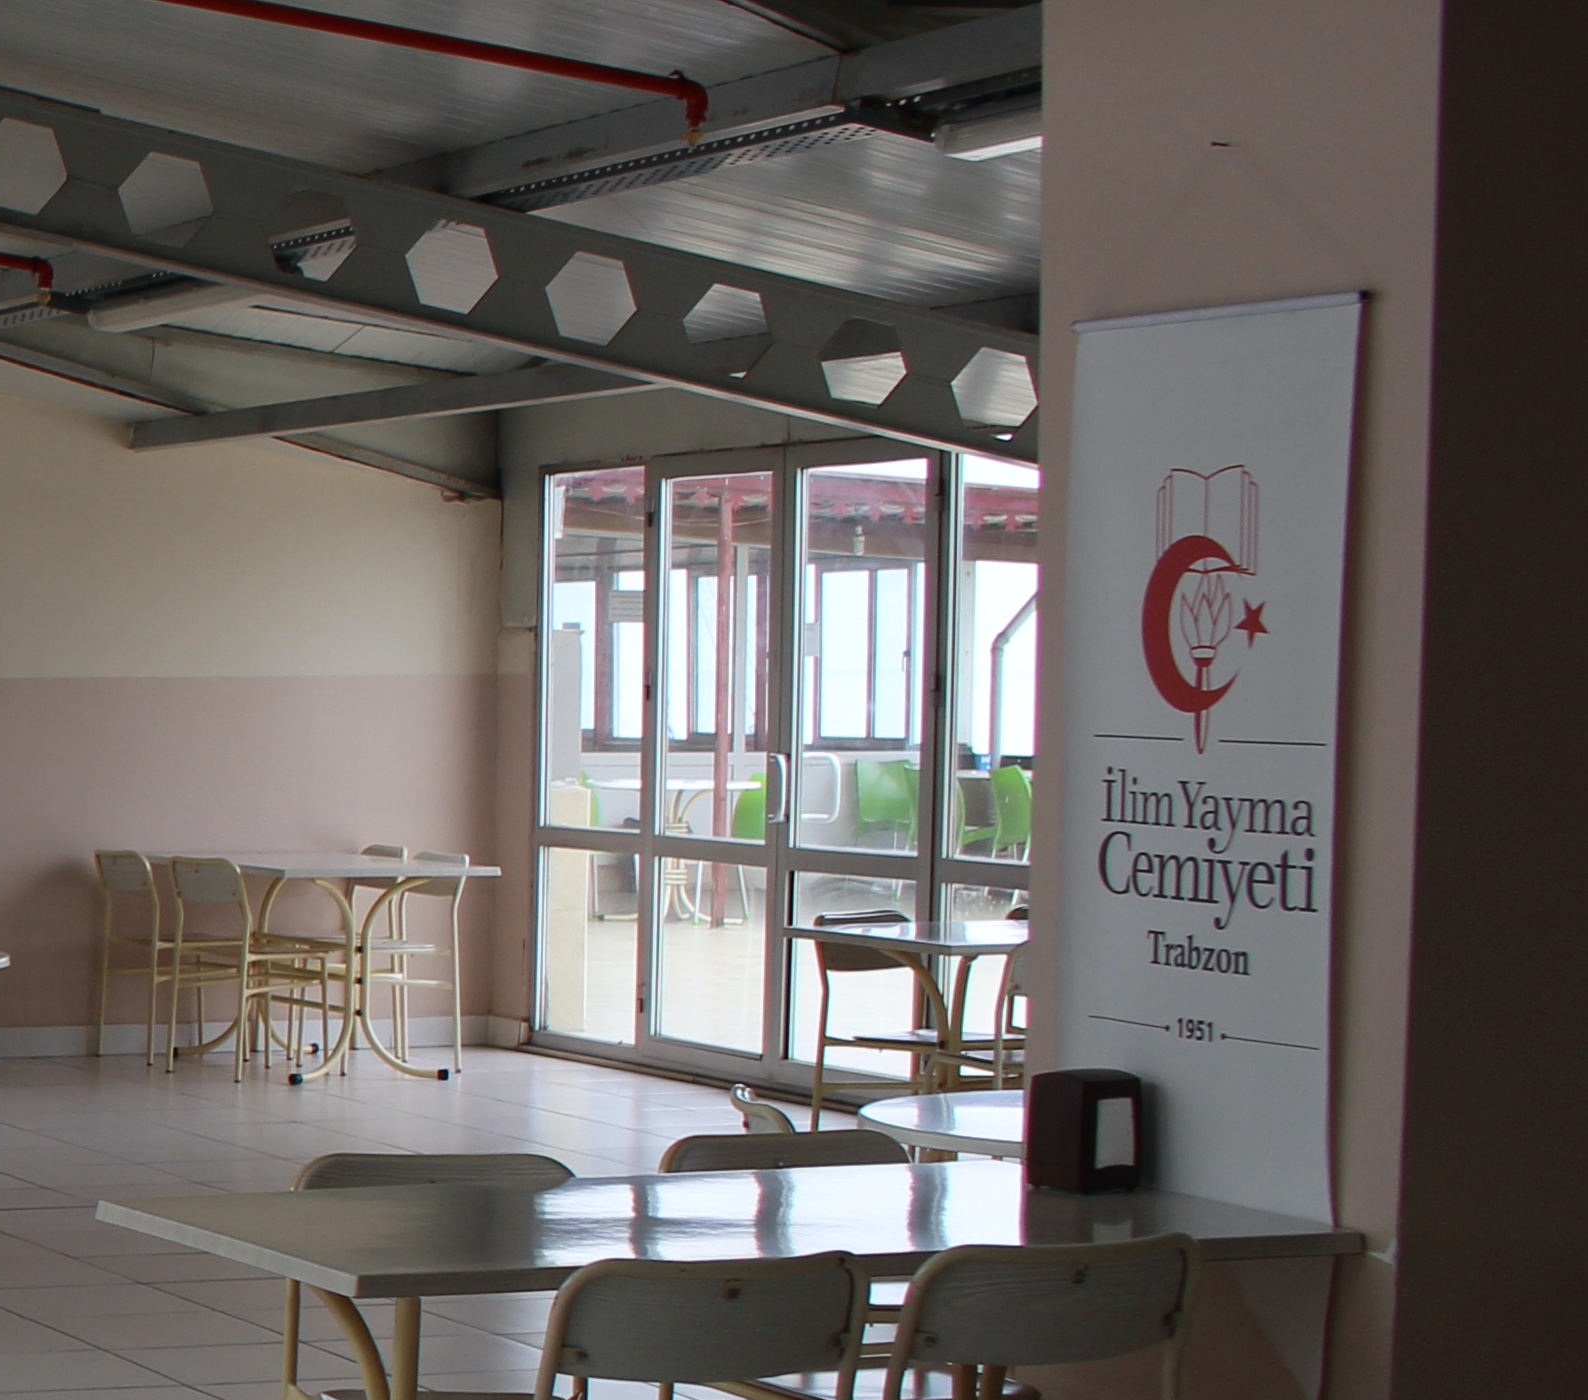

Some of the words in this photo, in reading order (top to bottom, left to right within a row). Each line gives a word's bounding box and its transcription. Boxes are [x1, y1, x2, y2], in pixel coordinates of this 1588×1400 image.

[1101, 766, 1176, 828] İlim
[1177, 780, 1316, 854] Yayma
[1098, 830, 1319, 930] Cemiyeti
[1147, 930, 1251, 976] Trabzon
[1177, 1017, 1214, 1043] 1951
